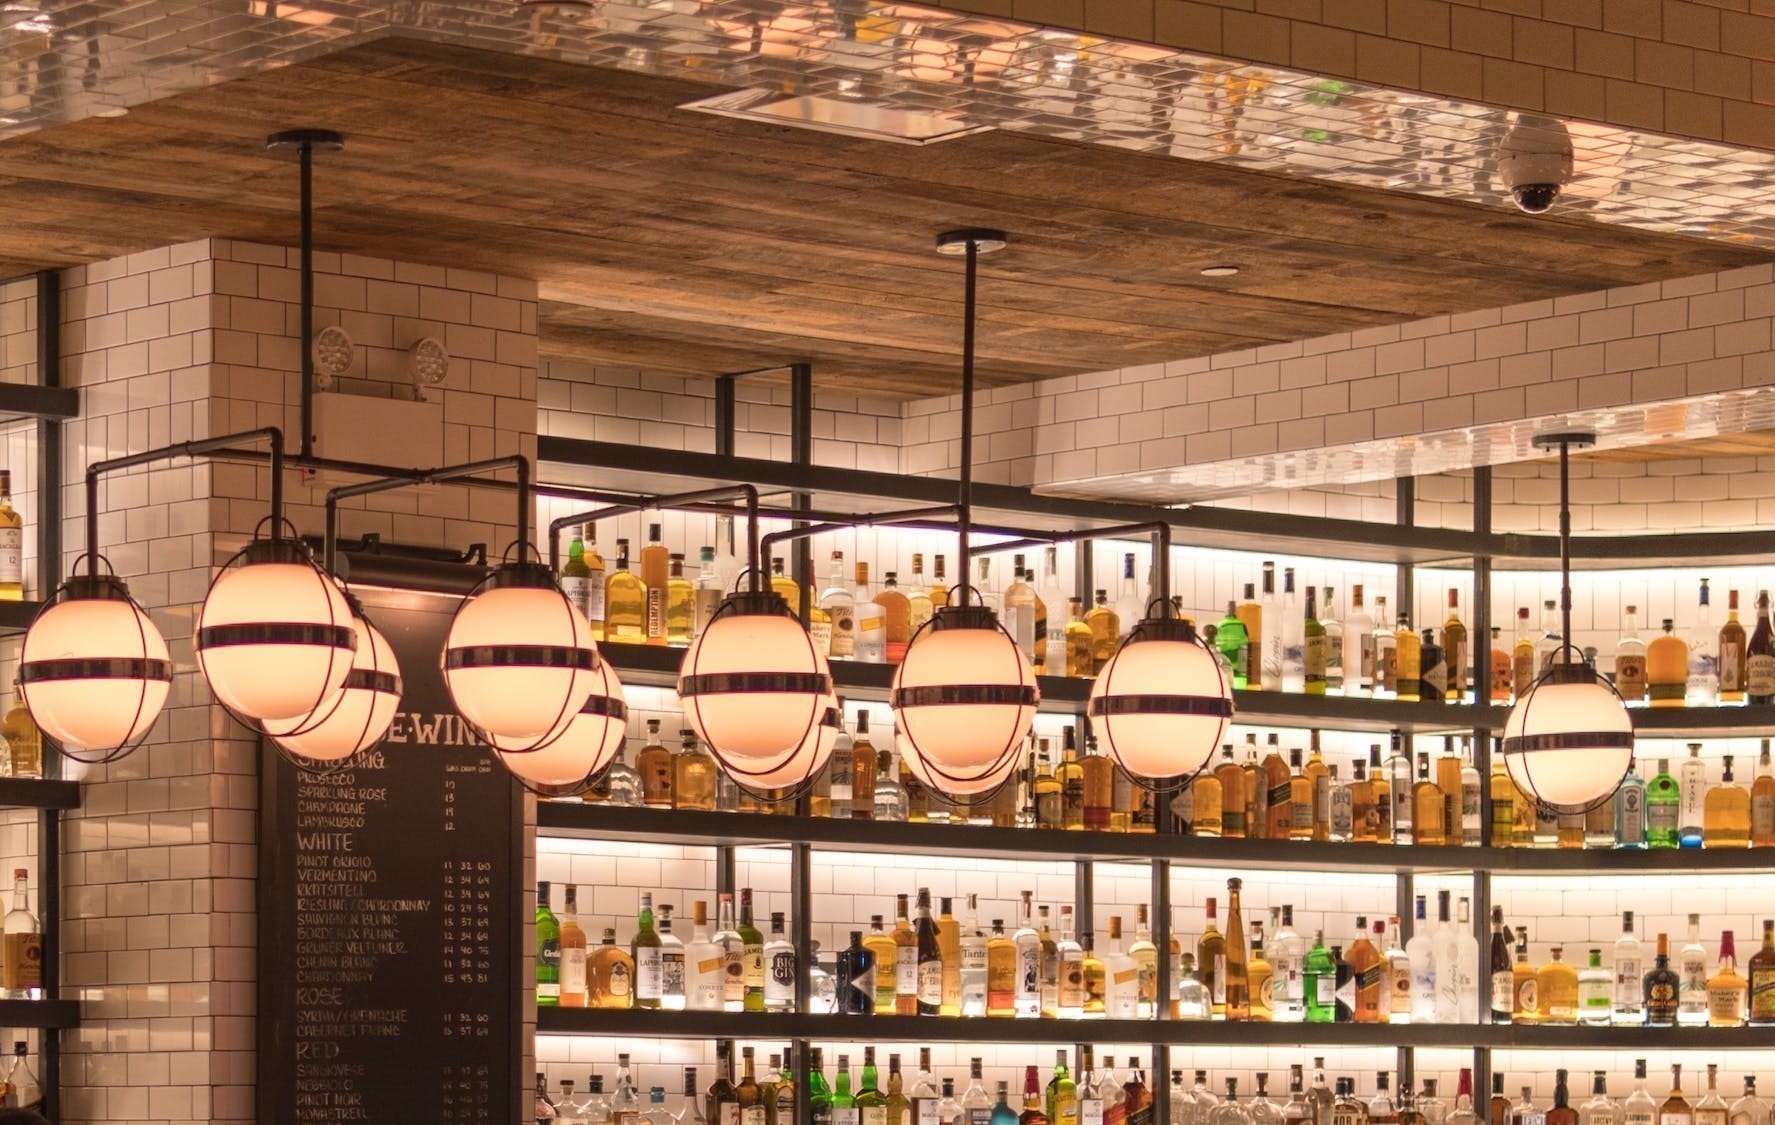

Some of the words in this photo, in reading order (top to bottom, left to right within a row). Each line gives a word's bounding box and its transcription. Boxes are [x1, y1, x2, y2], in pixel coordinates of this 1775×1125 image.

[650, 590, 659, 637] REDEMPTION
[297, 786, 356, 800] SPARKLING
[297, 801, 366, 815] CHAMPAGNE
[297, 814, 365, 828] LAMBRUSCO
[297, 832, 353, 851] WHITE
[297, 855, 329, 867] PINOT
[333, 856, 372, 868] GRIGIO
[297, 869, 377, 882] VERMENTINO
[776, 955, 795, 968] BIG
[296, 987, 344, 1006] ROSE
[296, 1041, 340, 1061] RED
